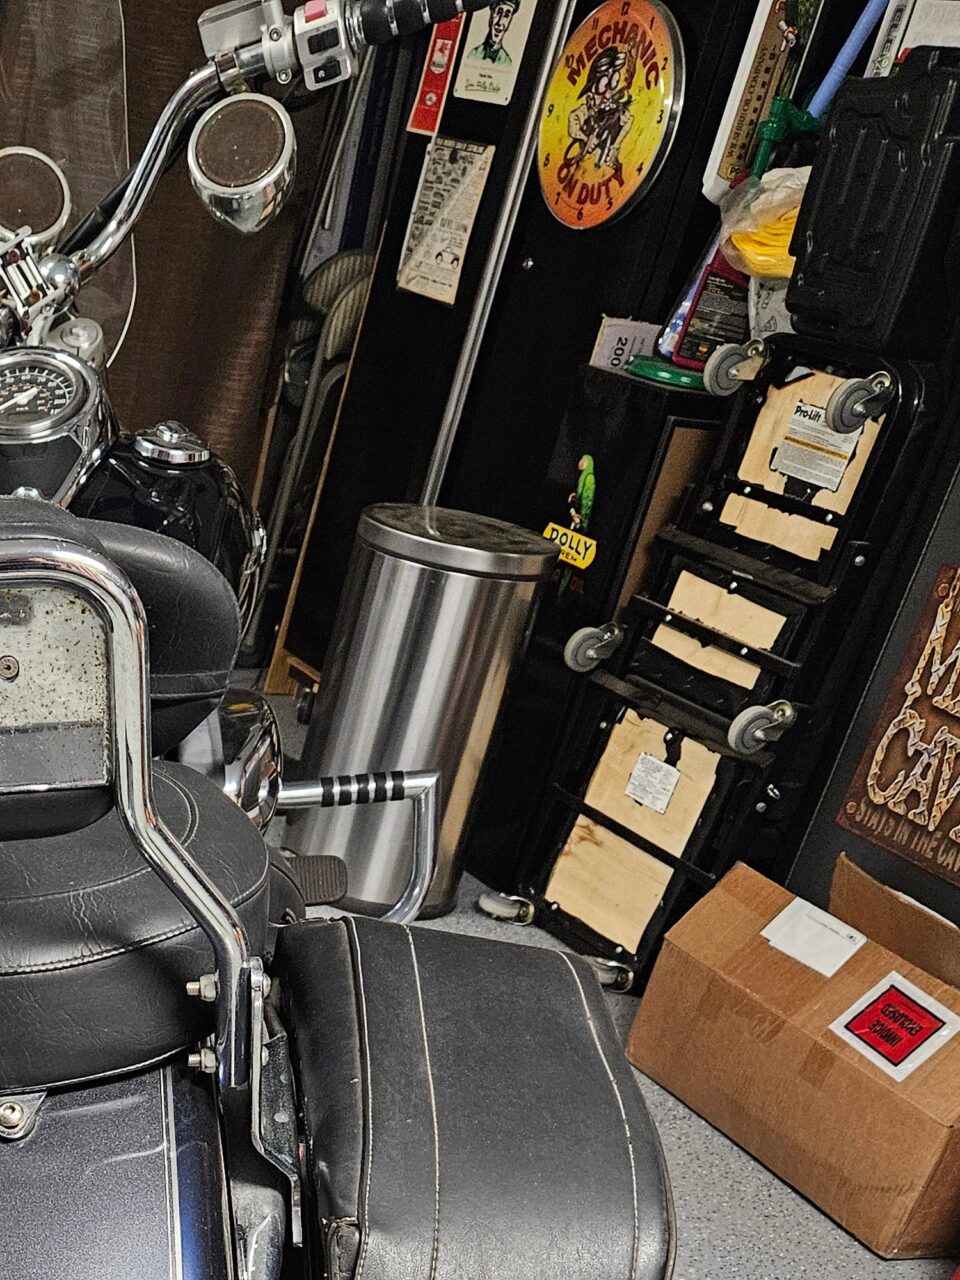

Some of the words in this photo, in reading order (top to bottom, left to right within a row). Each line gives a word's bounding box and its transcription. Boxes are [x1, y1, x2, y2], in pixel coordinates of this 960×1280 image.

[566, 21, 660, 91] MECHANIC
[661, 58, 668, 71] 2
[547, 104, 555, 118] 9
[656, 110, 663, 124] 3
[557, 162, 579, 199] ON
[576, 162, 625, 206] DUTY
[577, 207, 583, 220] 6
[610, 336, 628, 367] 200
[794, 405, 822, 423] Pro-Lift
[867, 709, 960, 831] CAV
[893, 819, 913, 845] IN
[910, 830, 943, 859] THE
[868, 1018, 904, 1047] INVOICE
[880, 1002, 924, 1037] ENCLOSED
